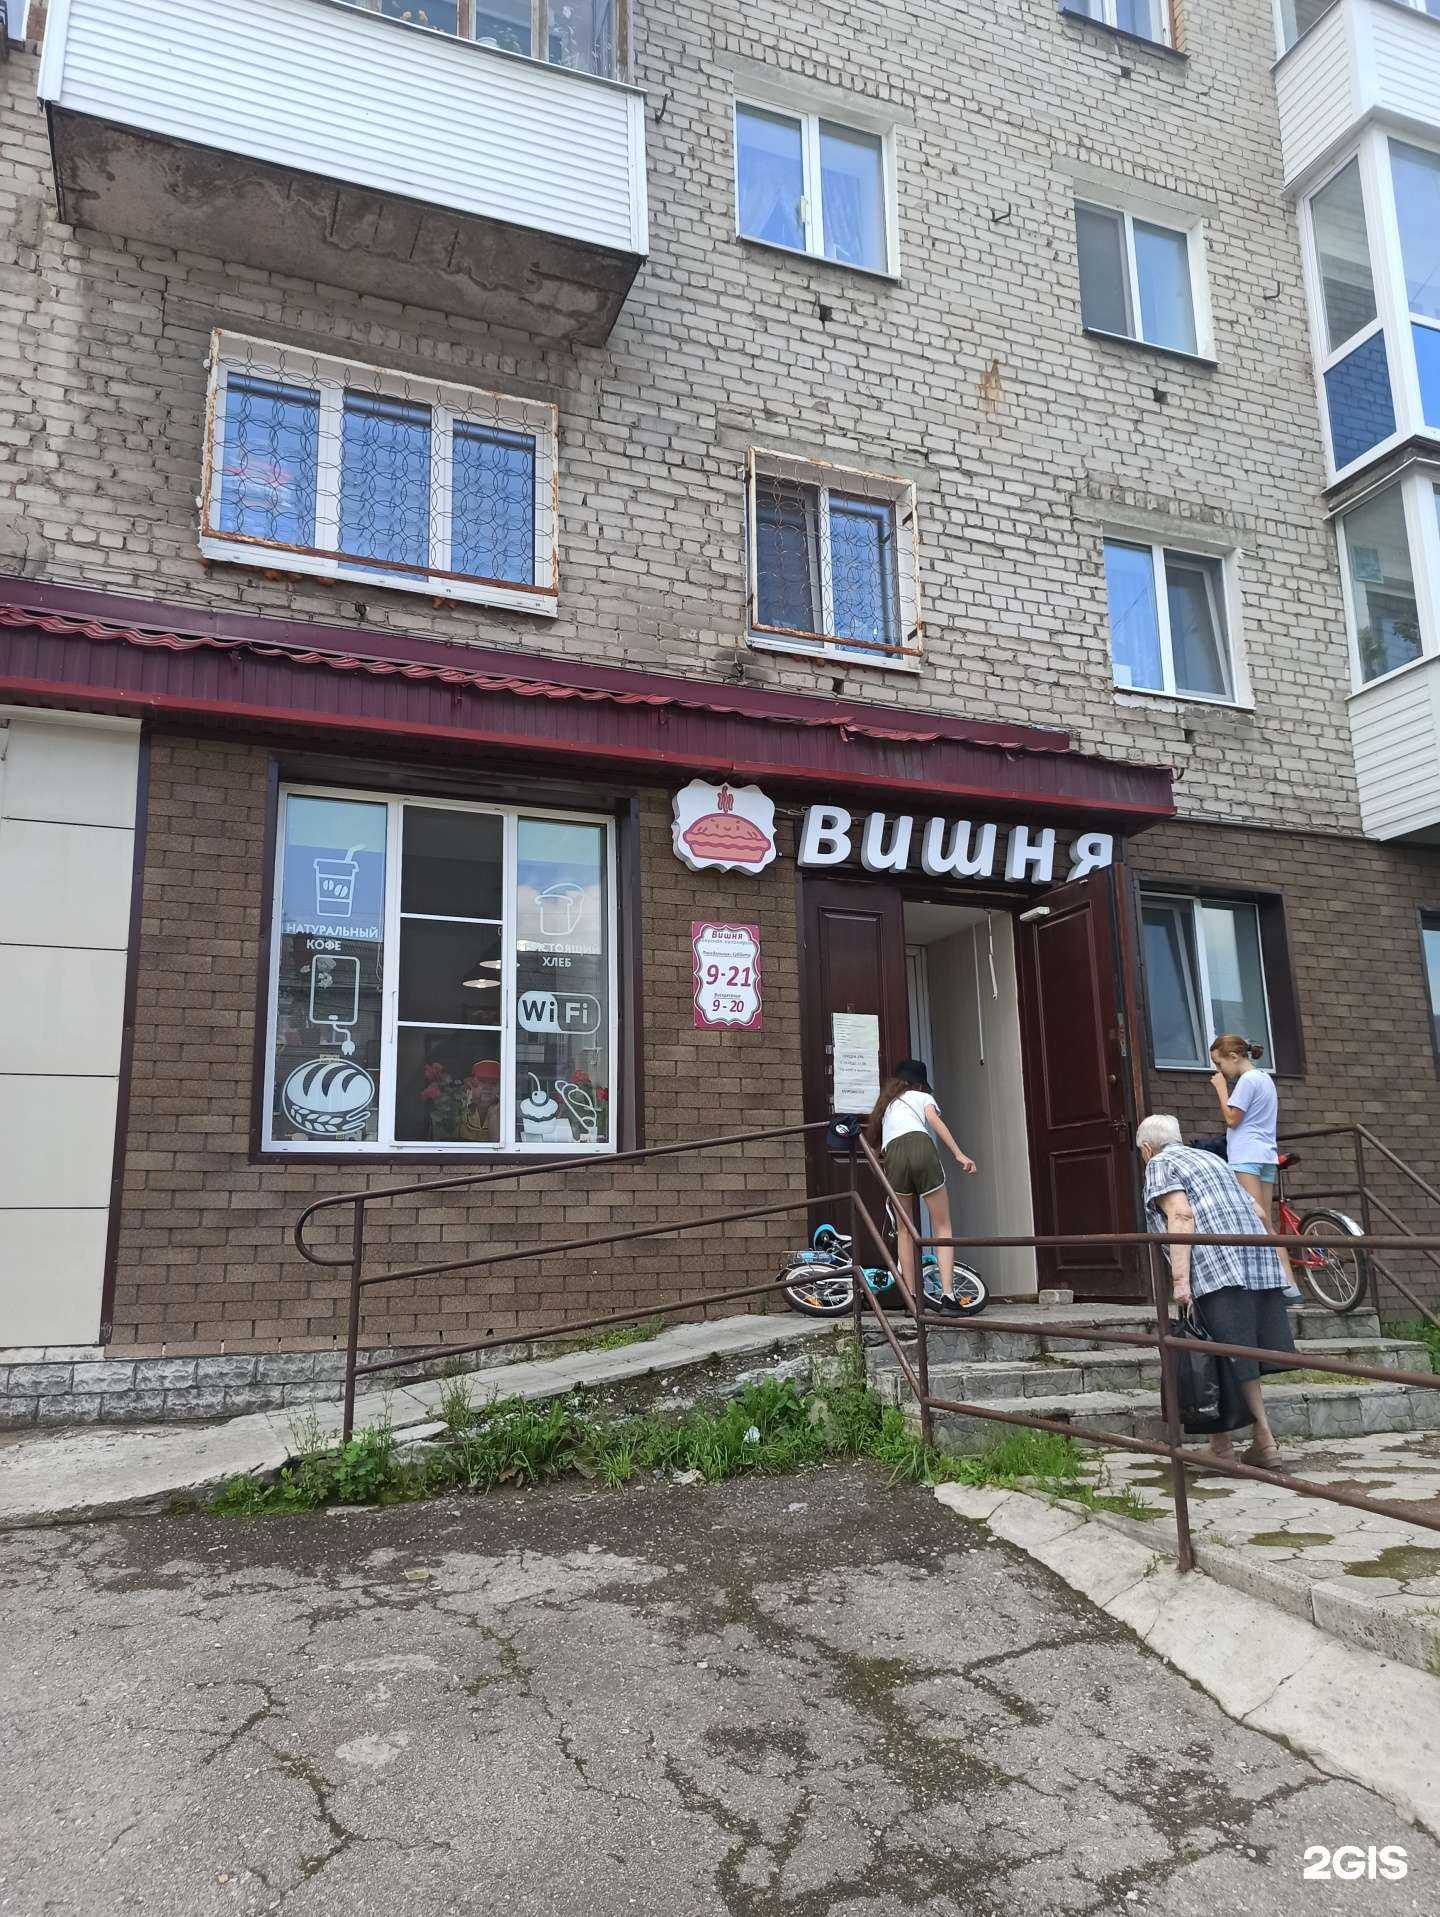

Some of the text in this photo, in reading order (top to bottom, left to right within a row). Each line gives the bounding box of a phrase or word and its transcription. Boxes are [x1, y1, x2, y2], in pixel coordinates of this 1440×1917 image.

[797, 804, 1114, 885] Вишня
[286, 923, 379, 938] НАТУРАЛЬНЫЙ
[306, 939, 342, 951] КОФЕ
[542, 957, 572, 968] ХЛЕБ
